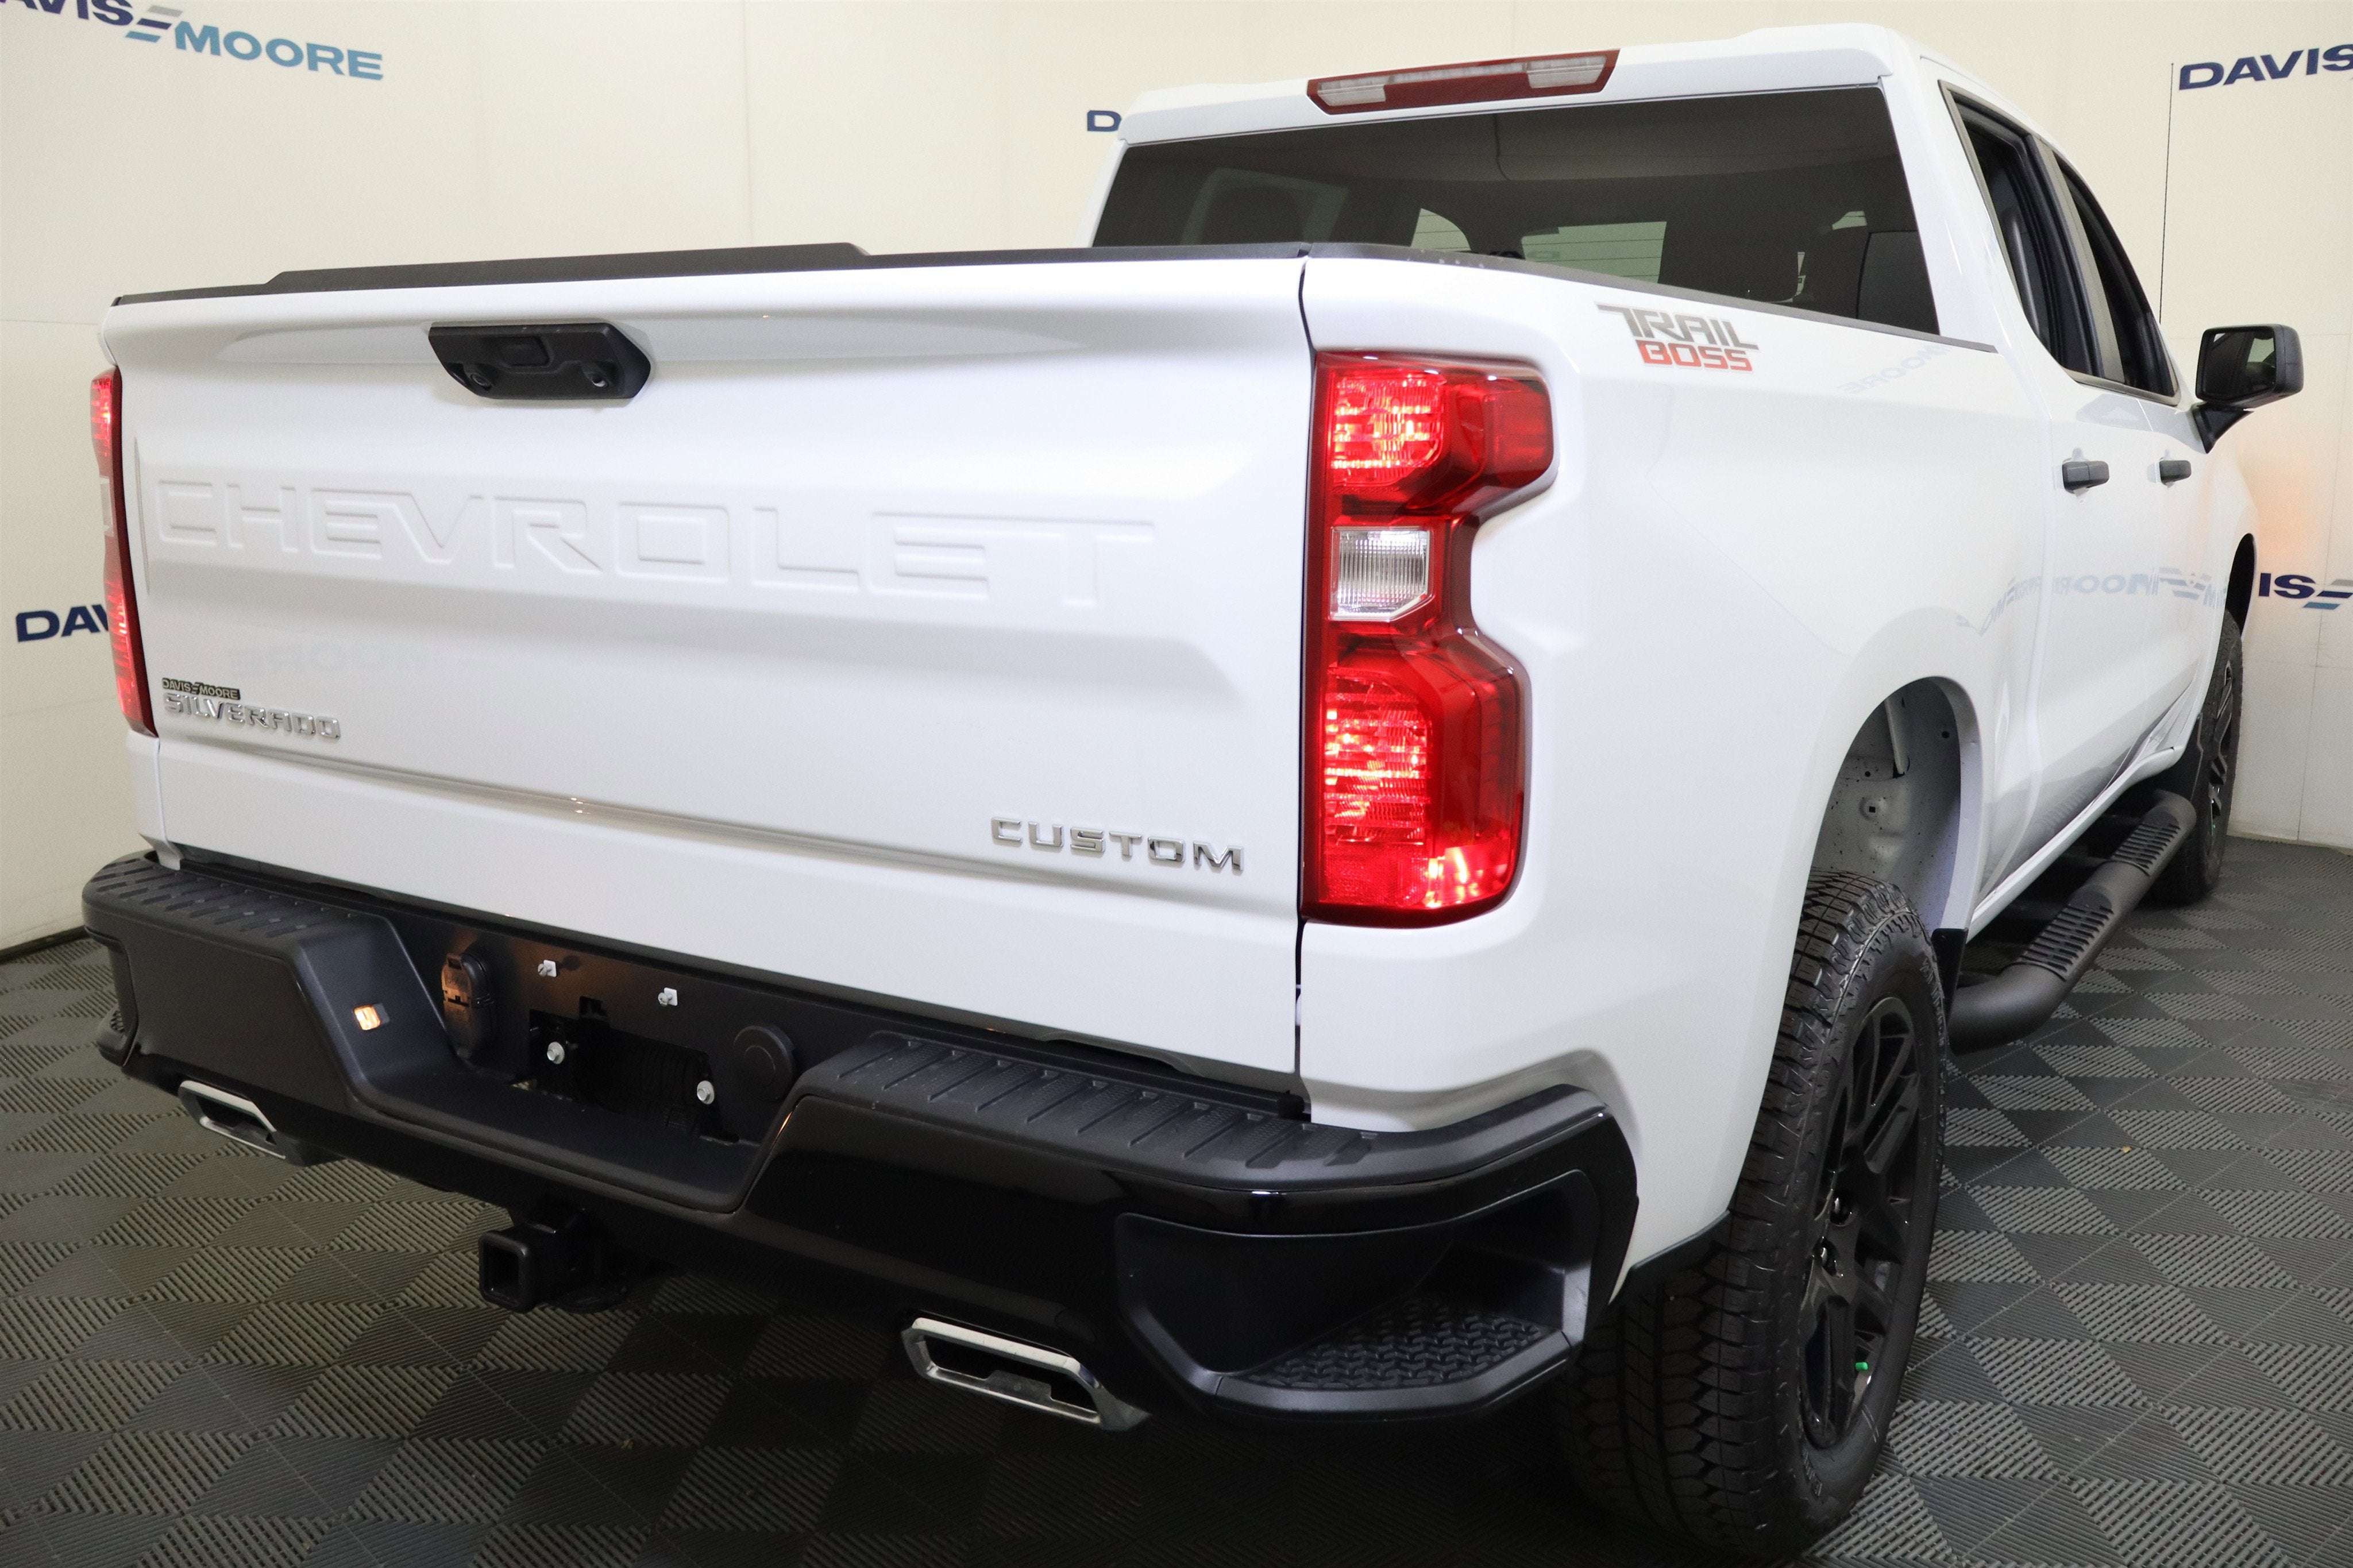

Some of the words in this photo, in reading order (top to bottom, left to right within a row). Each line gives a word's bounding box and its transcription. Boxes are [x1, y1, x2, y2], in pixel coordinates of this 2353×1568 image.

[175, 21, 384, 80] MOORE
[2179, 44, 2353, 90] DAVIS
[1595, 303, 1760, 350] TRAIL
[1635, 339, 1753, 372] BOSS
[157, 479, 1155, 609] CHEVROLET
[162, 678, 192, 693] DAVIS
[199, 684, 238, 699] MOORE
[164, 692, 342, 739] SILVERADO
[990, 817, 1244, 871] CUSTOM
